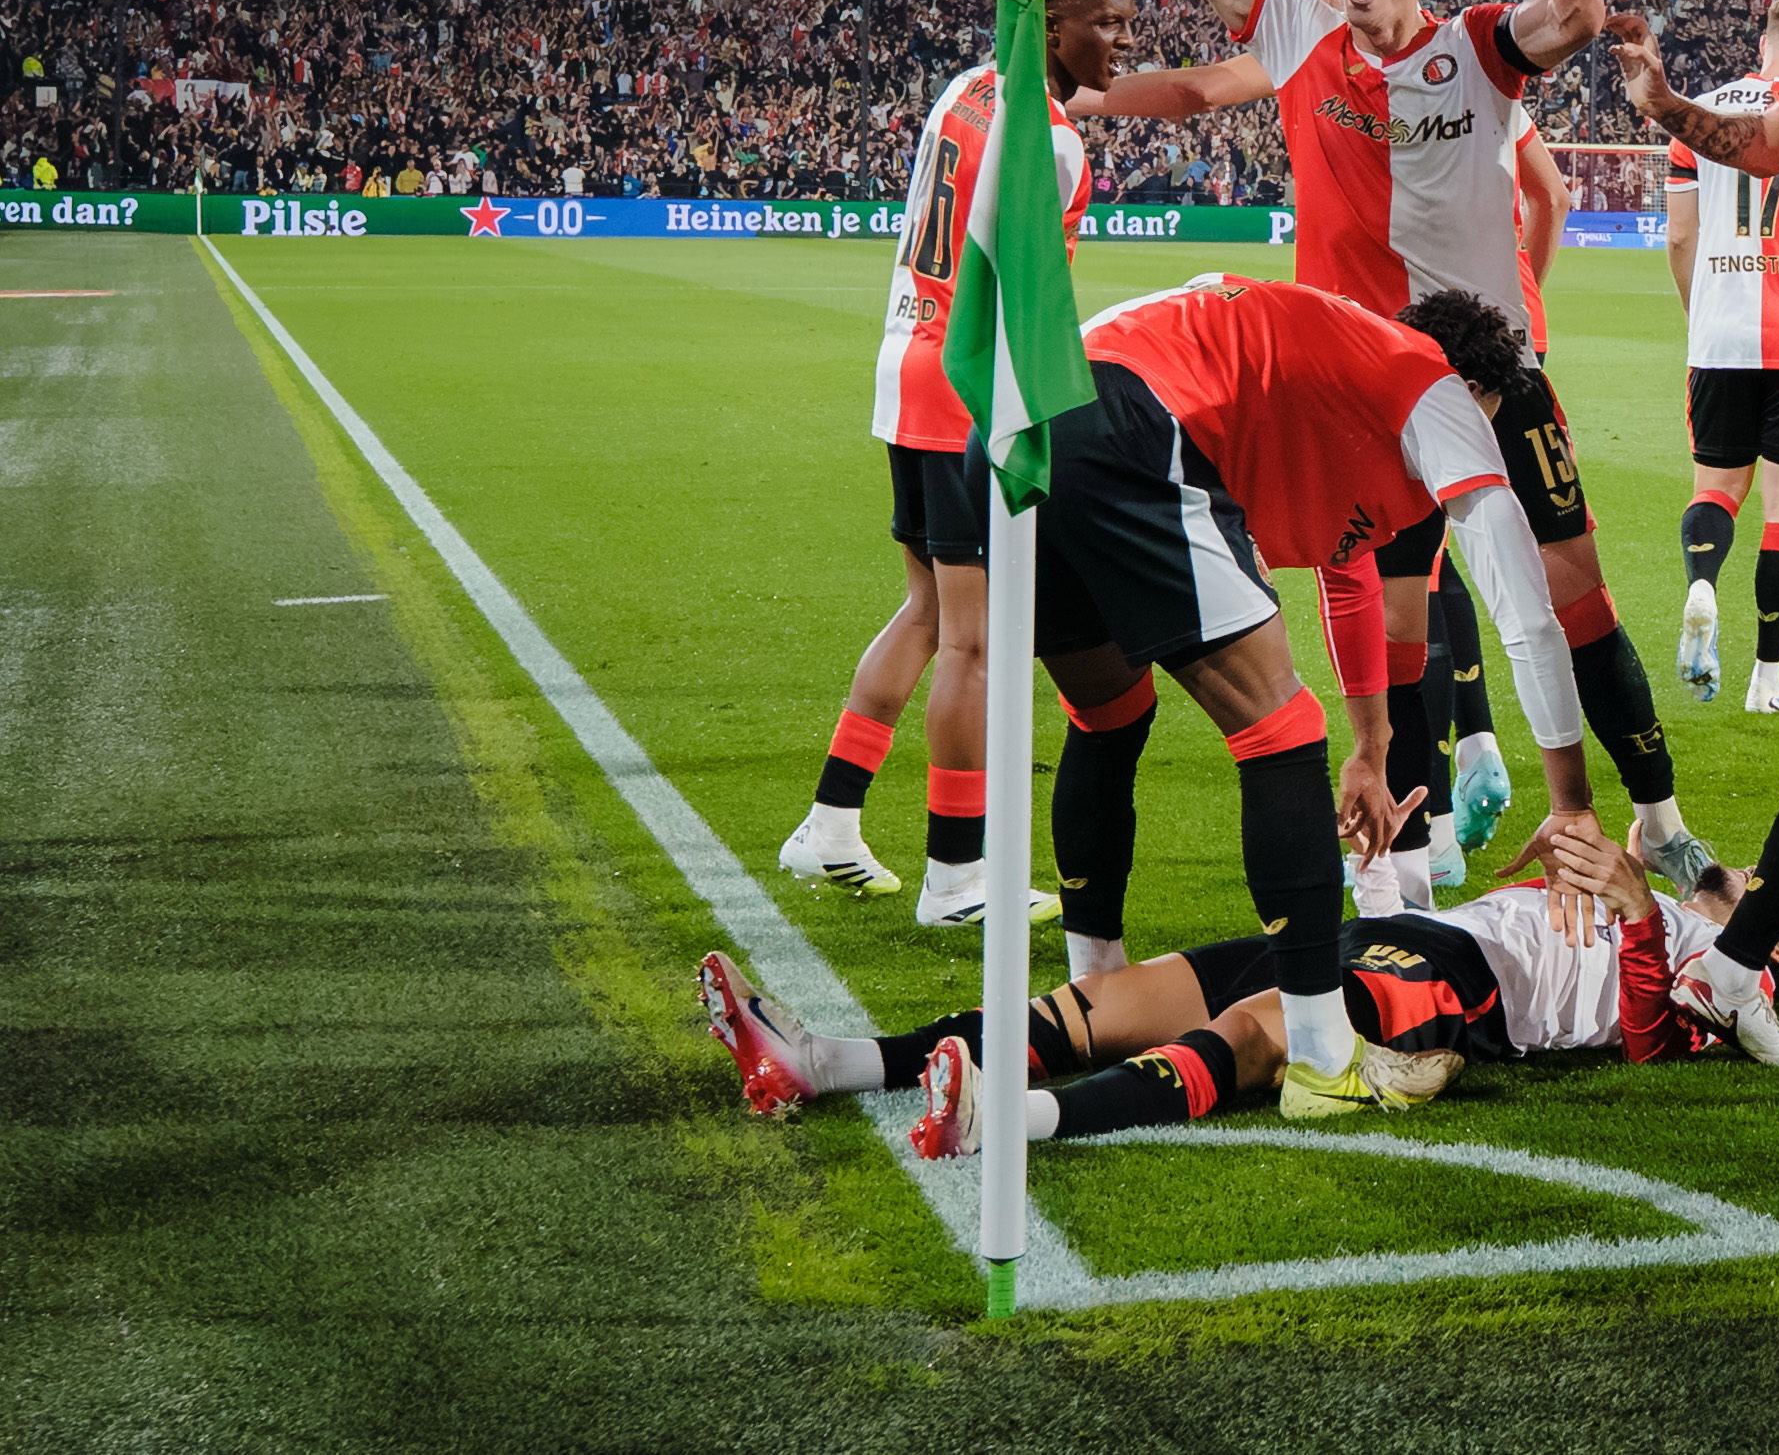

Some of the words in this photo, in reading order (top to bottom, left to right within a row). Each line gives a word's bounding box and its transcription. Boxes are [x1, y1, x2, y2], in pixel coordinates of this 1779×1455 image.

[52, 196, 139, 226] dan?
[666, 203, 822, 233] Heineken
[827, 205, 860, 239] je
[869, 205, 904, 234] da
[1106, 209, 1182, 236] dan?
[1523, 422, 1576, 490] 15
